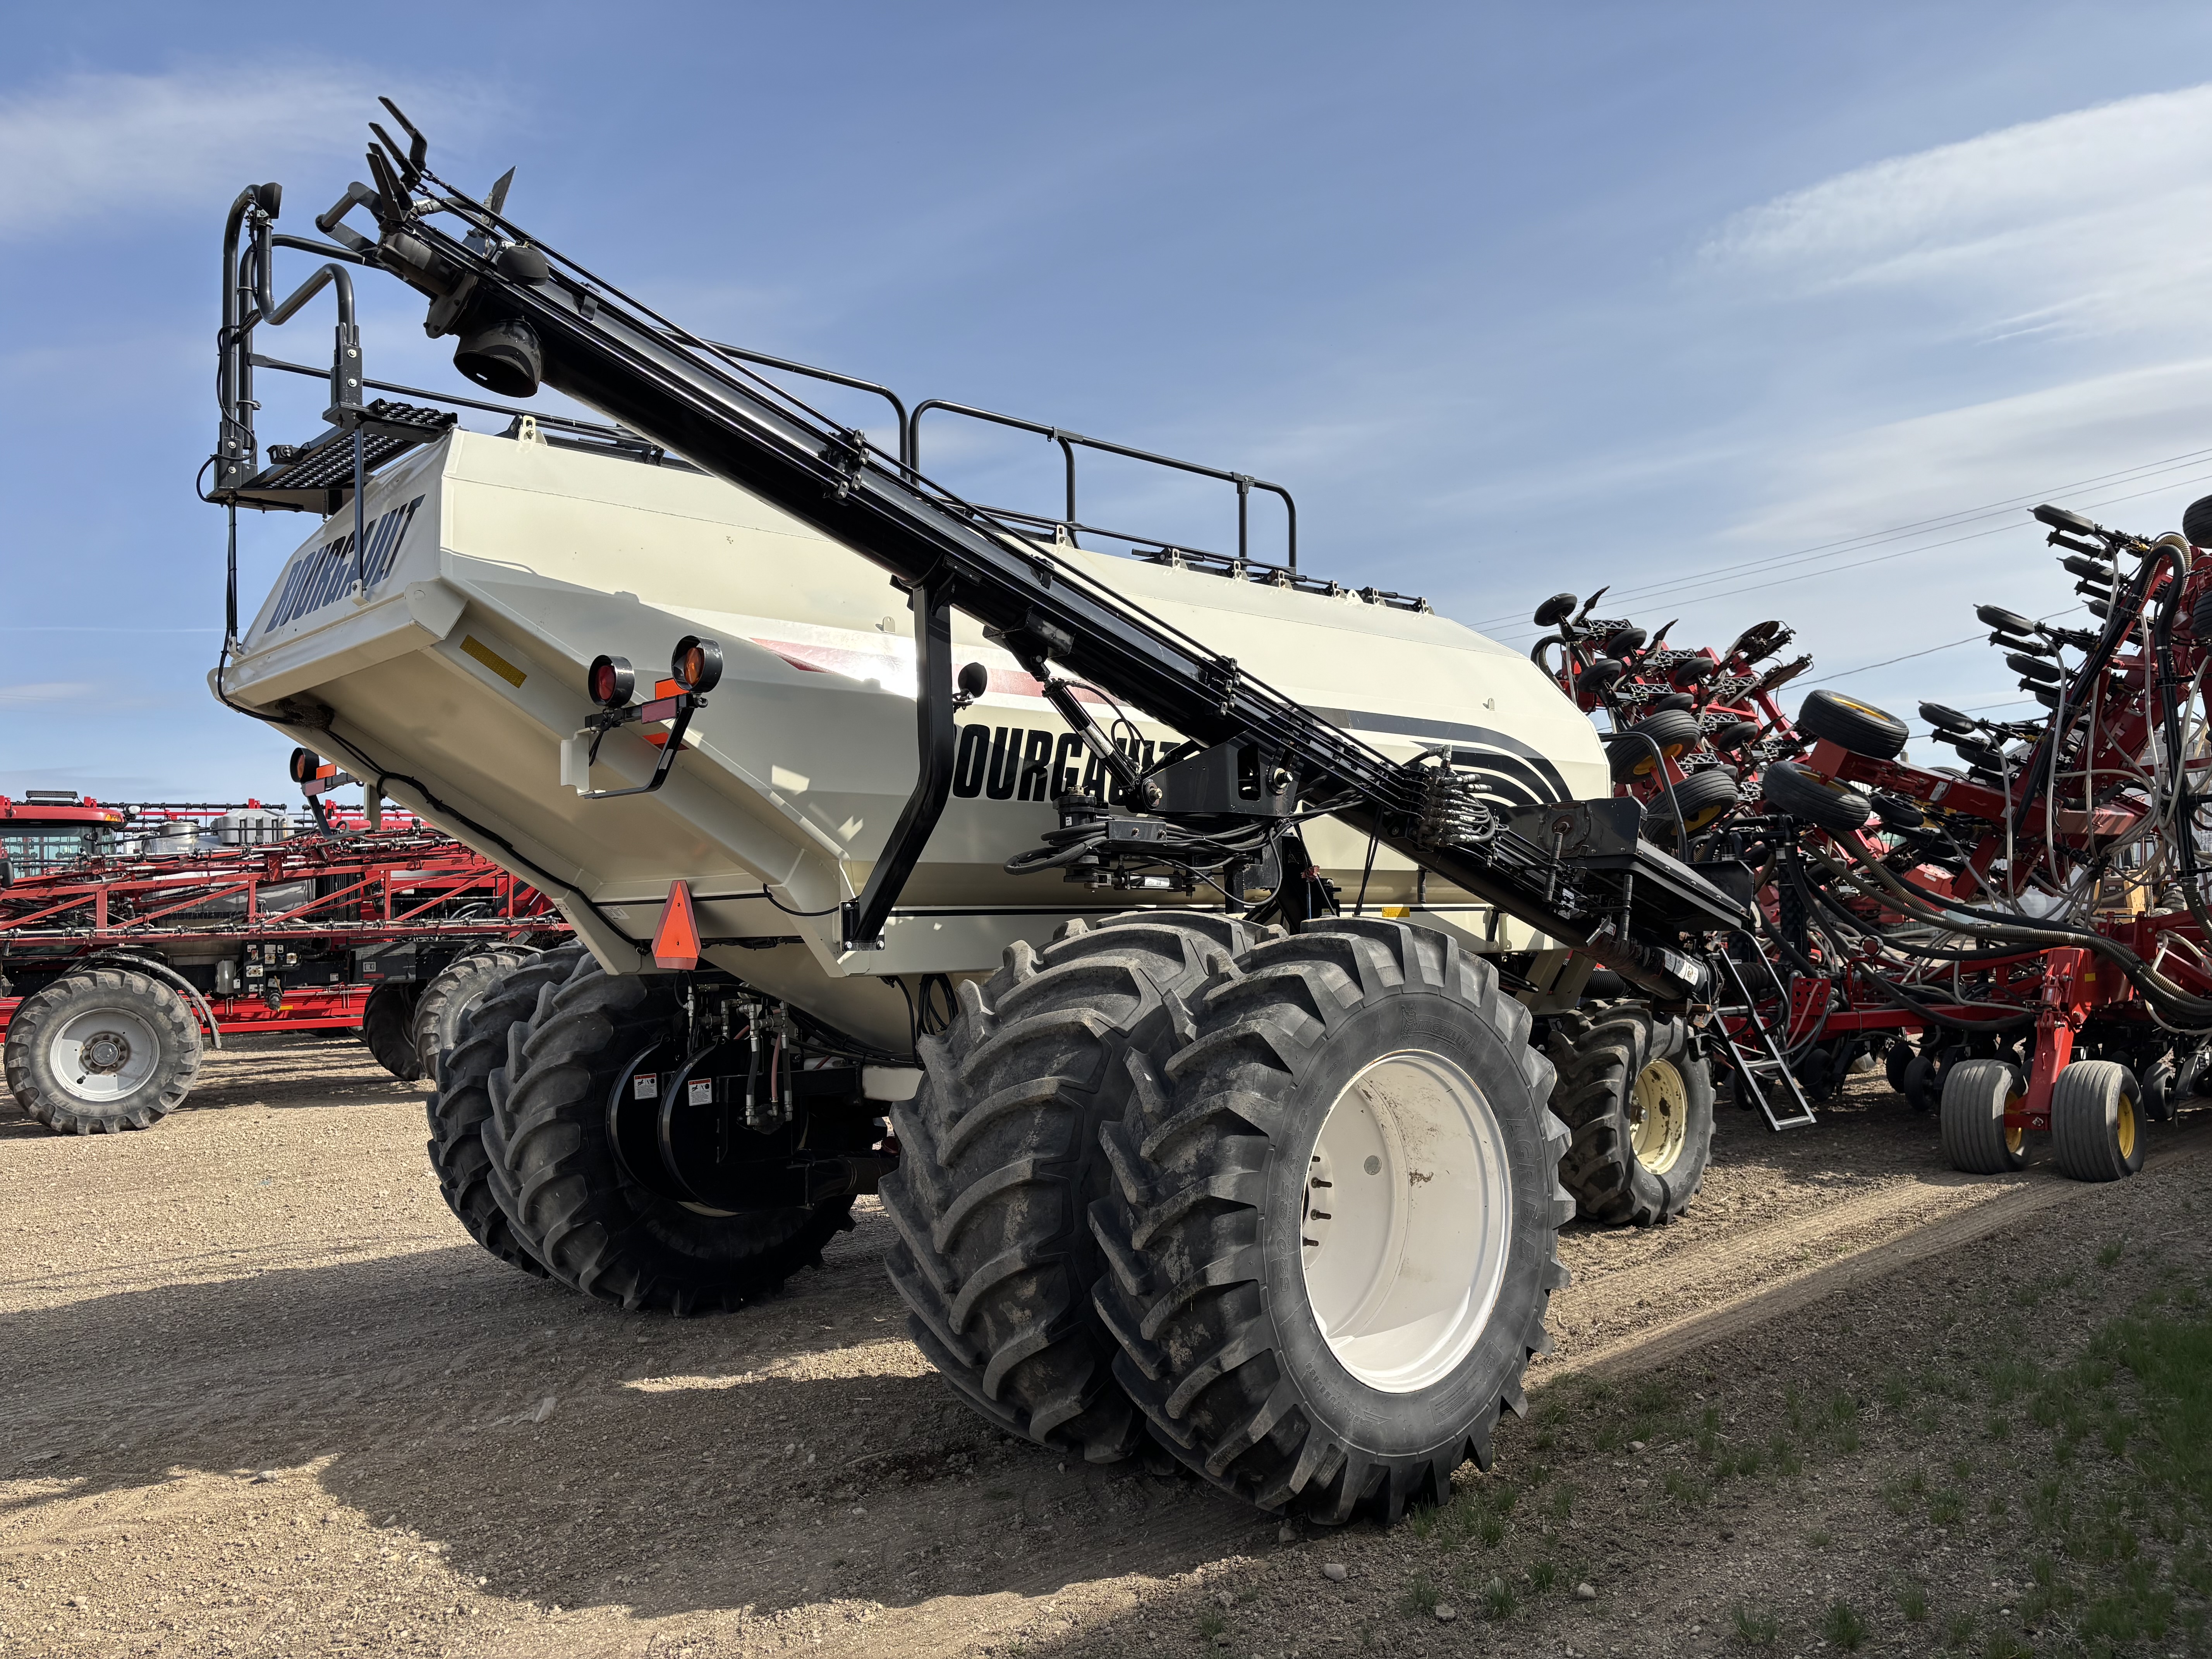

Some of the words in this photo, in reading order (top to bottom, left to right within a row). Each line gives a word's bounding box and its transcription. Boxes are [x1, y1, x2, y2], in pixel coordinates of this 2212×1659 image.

[264, 494, 426, 634] BOURGAULT
[1415, 1020, 1470, 1049] MICHELIN
[1505, 1118, 1538, 1266] AGRIBIB
[1277, 1180, 1290, 1292] 520/85
[1305, 1362, 1340, 1410] TUBELESS
[1343, 1407, 1373, 1429] RADIAL
